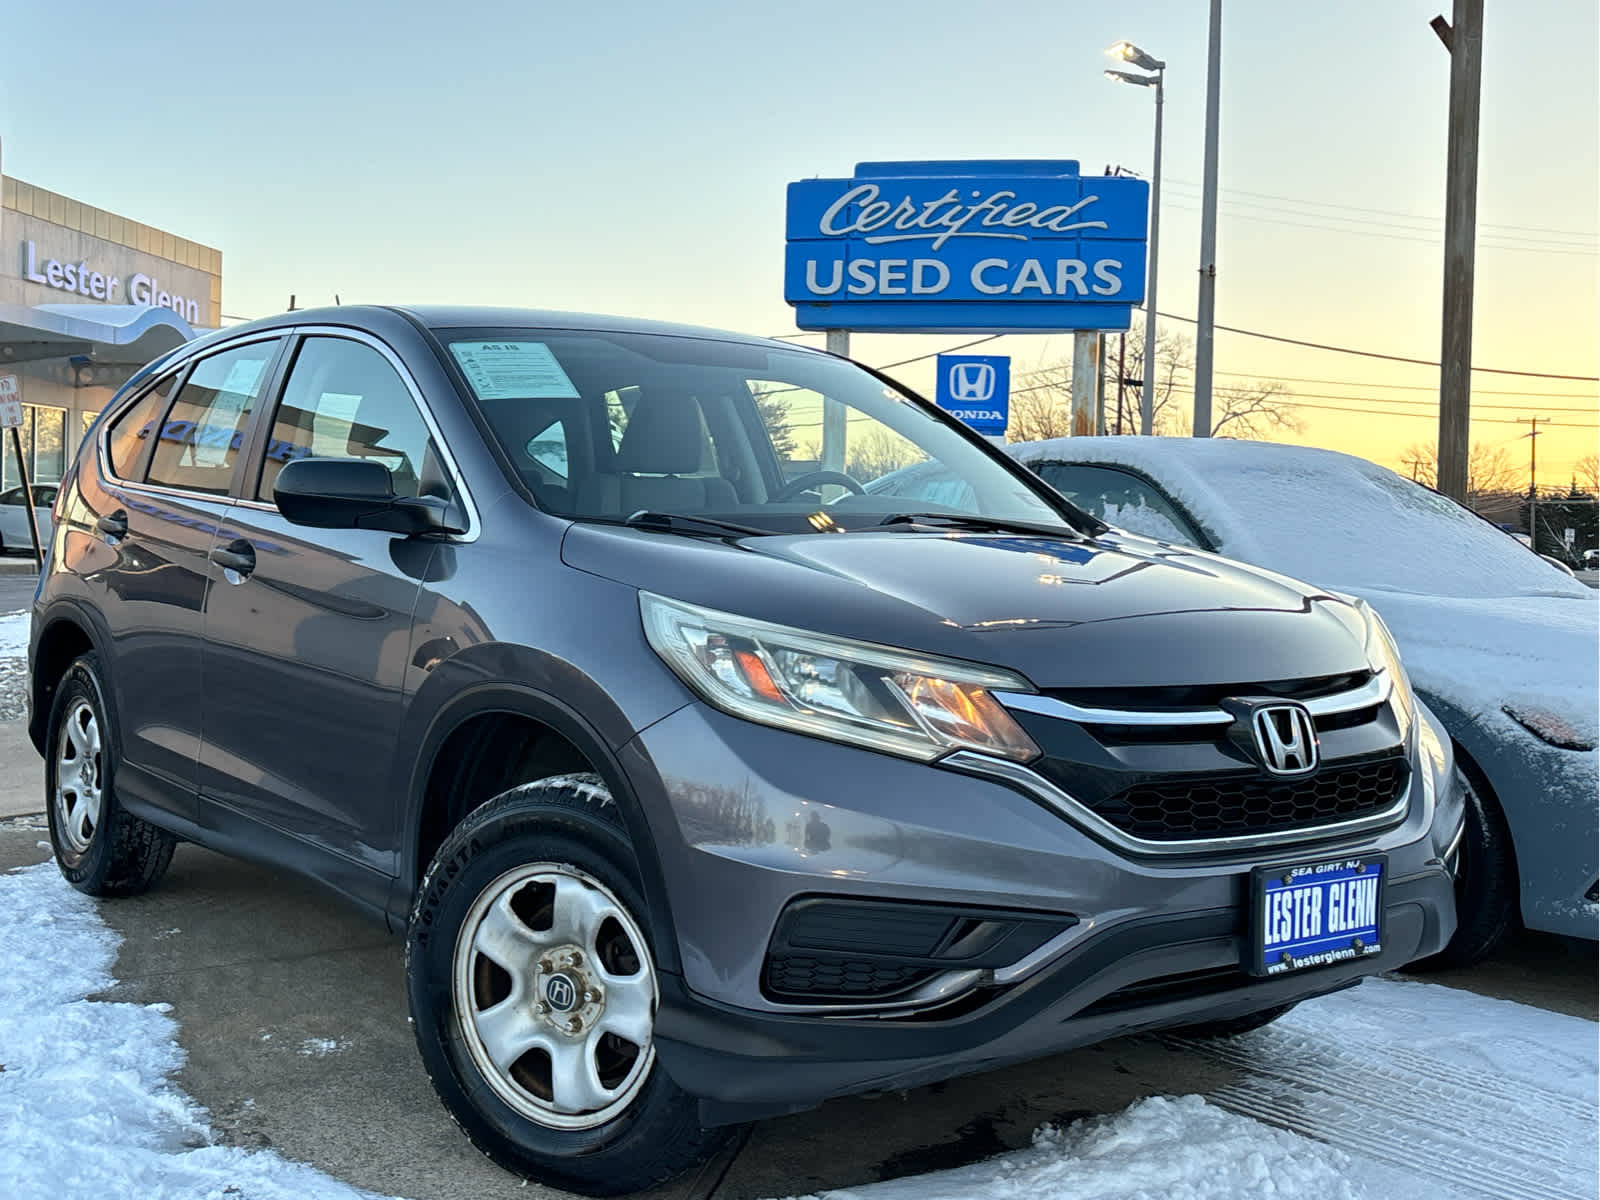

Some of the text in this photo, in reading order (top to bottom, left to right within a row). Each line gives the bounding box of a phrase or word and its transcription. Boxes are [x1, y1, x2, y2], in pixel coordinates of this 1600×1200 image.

[819, 184, 1108, 251] Certified
[25, 240, 199, 324] Lester Glenn
[805, 258, 1123, 295] USED CARS
[1291, 859, 1360, 878] SEA GIRT, NJ
[1264, 877, 1378, 946] LESTER GLENN
[1292, 948, 1356, 970] lesterglenn
